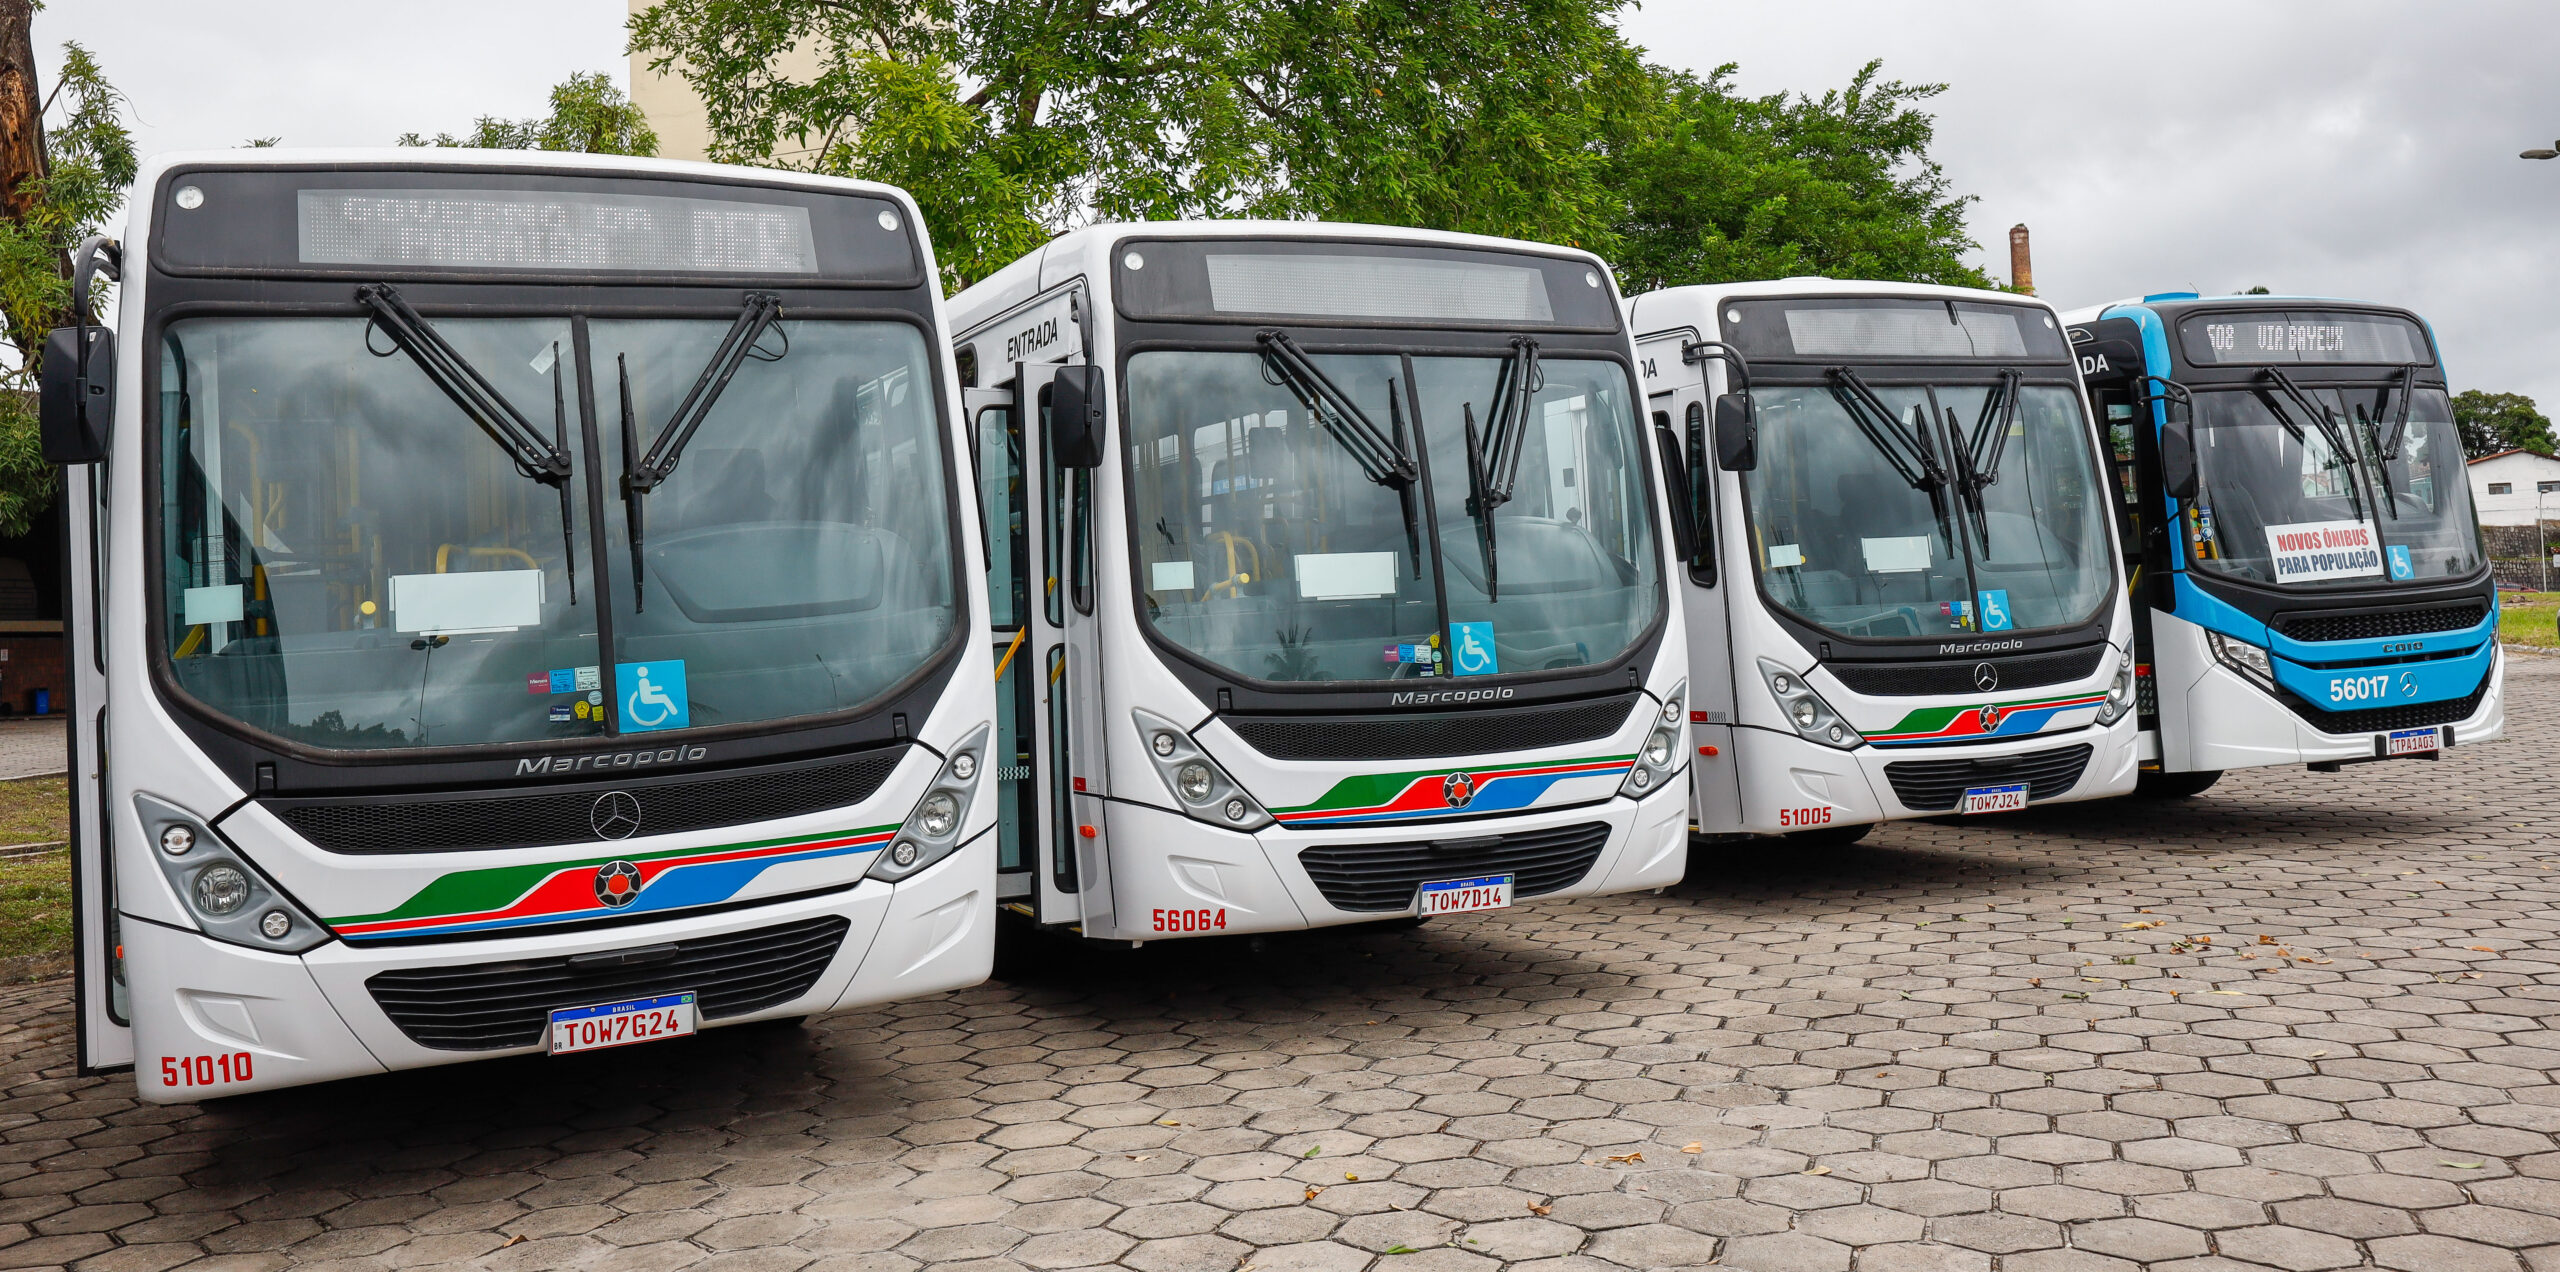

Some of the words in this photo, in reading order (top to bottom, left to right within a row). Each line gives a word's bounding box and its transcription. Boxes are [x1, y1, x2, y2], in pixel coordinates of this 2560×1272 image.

[1007, 317, 1059, 363] ENTRADA
[2257, 325, 2284, 351] VIA
[2288, 325, 2344, 351] BAYEUX
[2277, 531, 2321, 552] NOVOS
[2323, 528, 2369, 548] ÔNIBUS
[2277, 555, 2311, 575] PARA
[2311, 547, 2378, 572] POPULAÇÃO
[1939, 639, 2023, 655] Marcopolo
[2382, 641, 2424, 654] CAIO
[1391, 686, 1514, 706] Marcopolo
[2330, 675, 2389, 702] 56017
[2395, 735, 2434, 753] TPA1A03
[515, 744, 707, 776] Marcopolo
[1970, 793, 2020, 811] TOW7J24
[1780, 806, 1832, 827] 51005
[1430, 887, 1501, 912] TOW7D14
[1153, 908, 1226, 932] 56064
[612, 1004, 636, 1013] BRASIL
[564, 1009, 679, 1047] TOW7G24
[554, 1041, 563, 1050] BR
[161, 1051, 253, 1087] 51010
